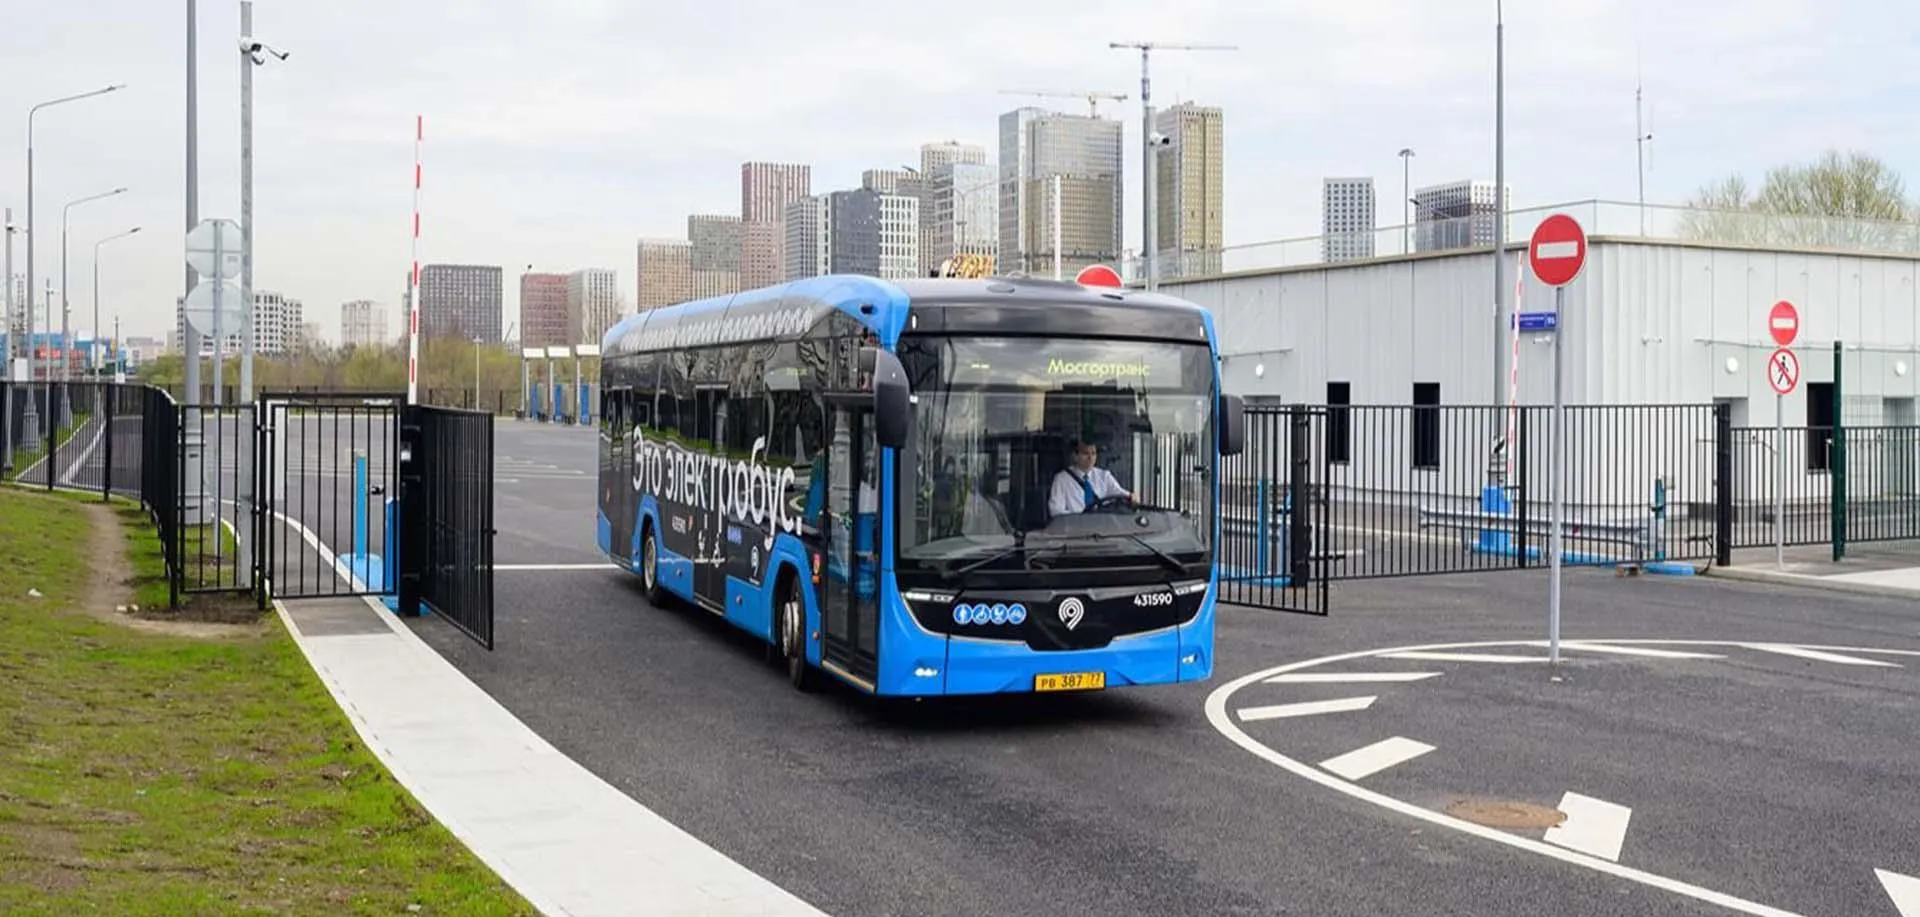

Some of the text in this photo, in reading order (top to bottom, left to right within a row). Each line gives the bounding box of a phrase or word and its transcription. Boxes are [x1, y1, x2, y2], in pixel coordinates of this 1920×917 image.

[1048, 358, 1150, 378] Мосгортранс
[632, 424, 802, 551] Это электробус.
[1134, 592, 1172, 607] 431590
[1060, 674, 1083, 688] 387
